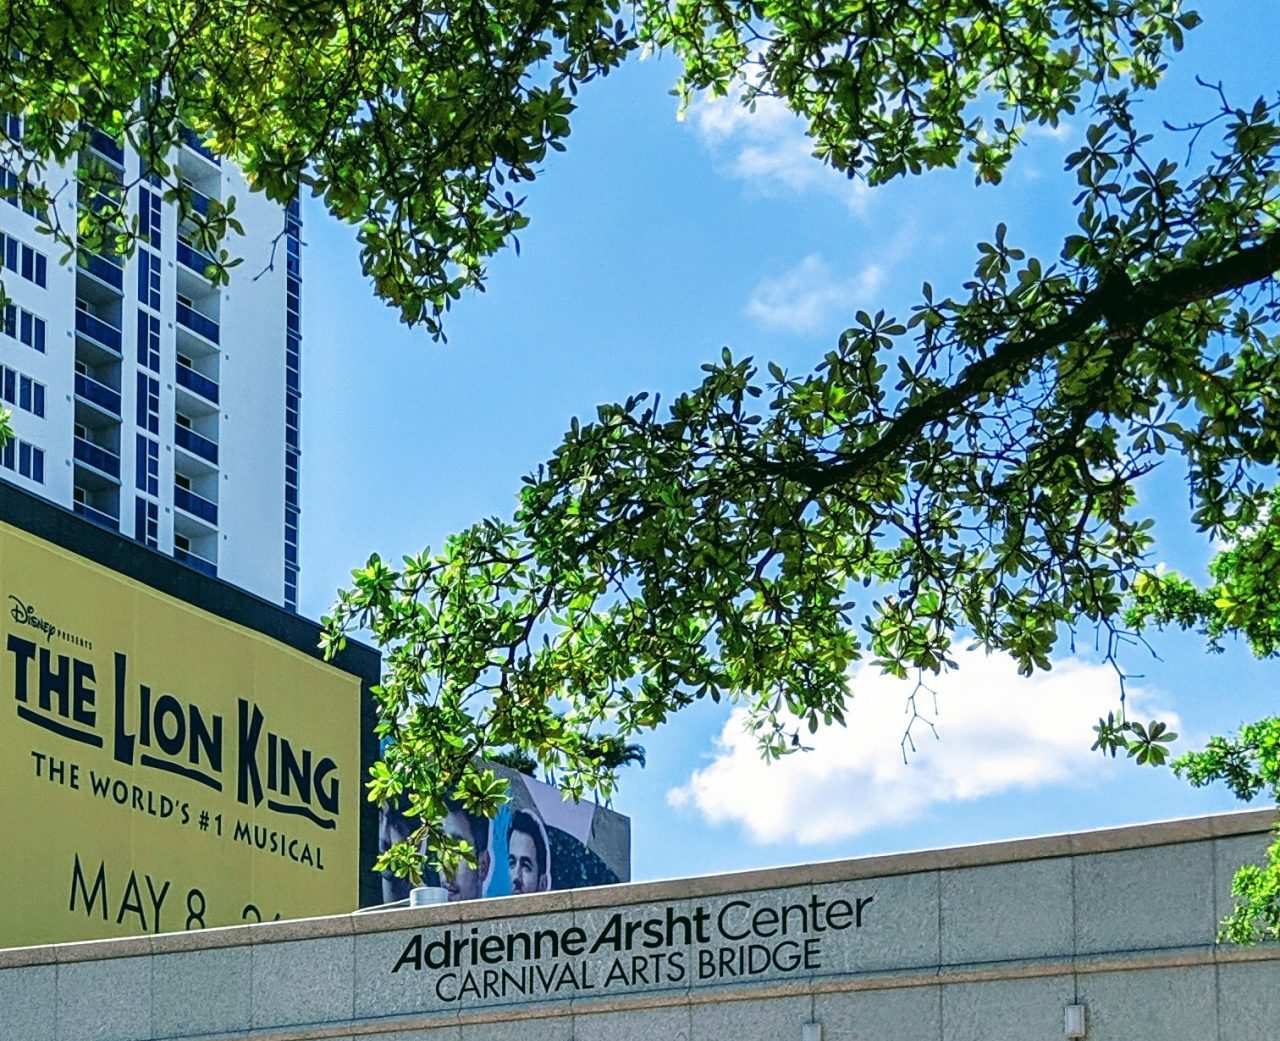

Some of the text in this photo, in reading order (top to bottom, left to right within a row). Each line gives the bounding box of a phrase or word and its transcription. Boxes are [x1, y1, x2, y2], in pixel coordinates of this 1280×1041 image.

[6, 633, 97, 727] THE
[58, 629, 93, 650] PRESENTS
[31, 751, 324, 871] THE WORLD'S #1 MUSICAL
[69, 852, 171, 934] MAY
[391, 893, 874, 974] Adrienne Arsht Center
[435, 938, 821, 1001] CARNIVAL ARTS BRIDGE
